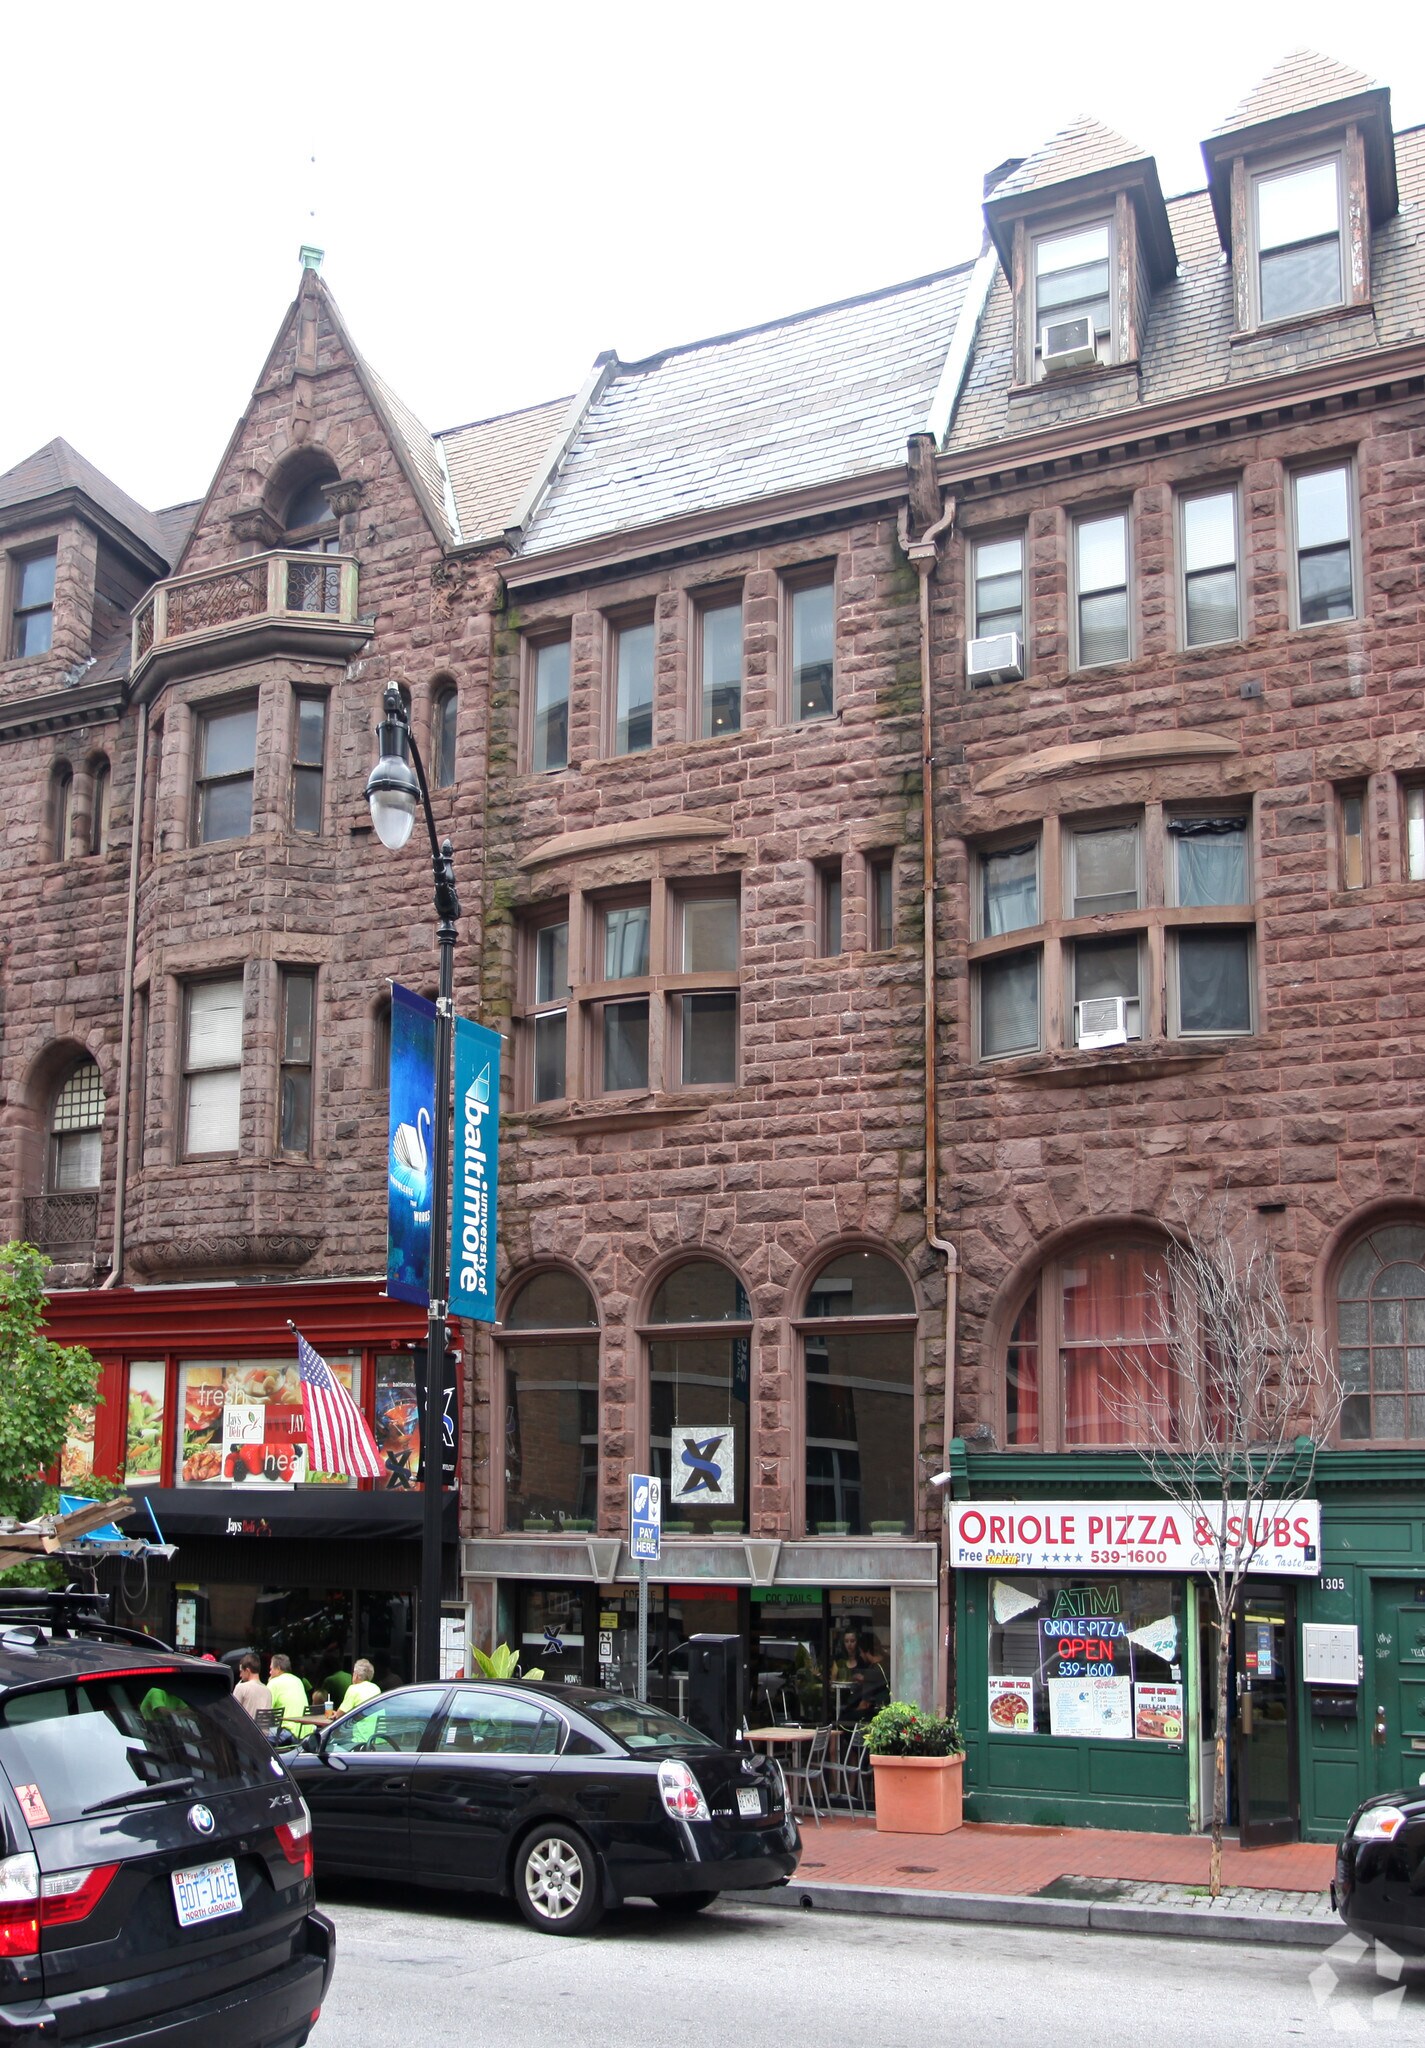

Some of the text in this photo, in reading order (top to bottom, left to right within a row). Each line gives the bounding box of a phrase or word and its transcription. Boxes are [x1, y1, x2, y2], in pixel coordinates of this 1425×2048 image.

[460, 1097, 489, 1293] baltimore
[477, 1193, 488, 1295] university of
[199, 1381, 246, 1406] fresh
[226, 1412, 241, 1427] Jay's
[229, 1426, 241, 1438] Deli
[639, 1527, 654, 1539] PAY
[958, 1510, 1311, 1548] ORIOLE PIZZA & SUBS
[636, 1541, 656, 1553] HERE
[959, 1548, 983, 1562] Free
[1090, 1550, 1167, 1564] 539-1600
[1191, 1552, 1218, 1566] Can't
[1253, 1553, 1270, 1567] The
[1320, 1578, 1345, 1590] 1305
[765, 1593, 812, 1604] COCTAILS
[1052, 1585, 1120, 1618] ATM
[1044, 1620, 1126, 1637] ORIOLE PIZZA
[1058, 1638, 1114, 1661] OPEN
[1058, 1662, 1113, 1677] 539-1600
[268, 1794, 293, 1808] X3
[178, 1872, 237, 1911] BDT-1415
[185, 1900, 236, 1920] NORTH CAROLINA
